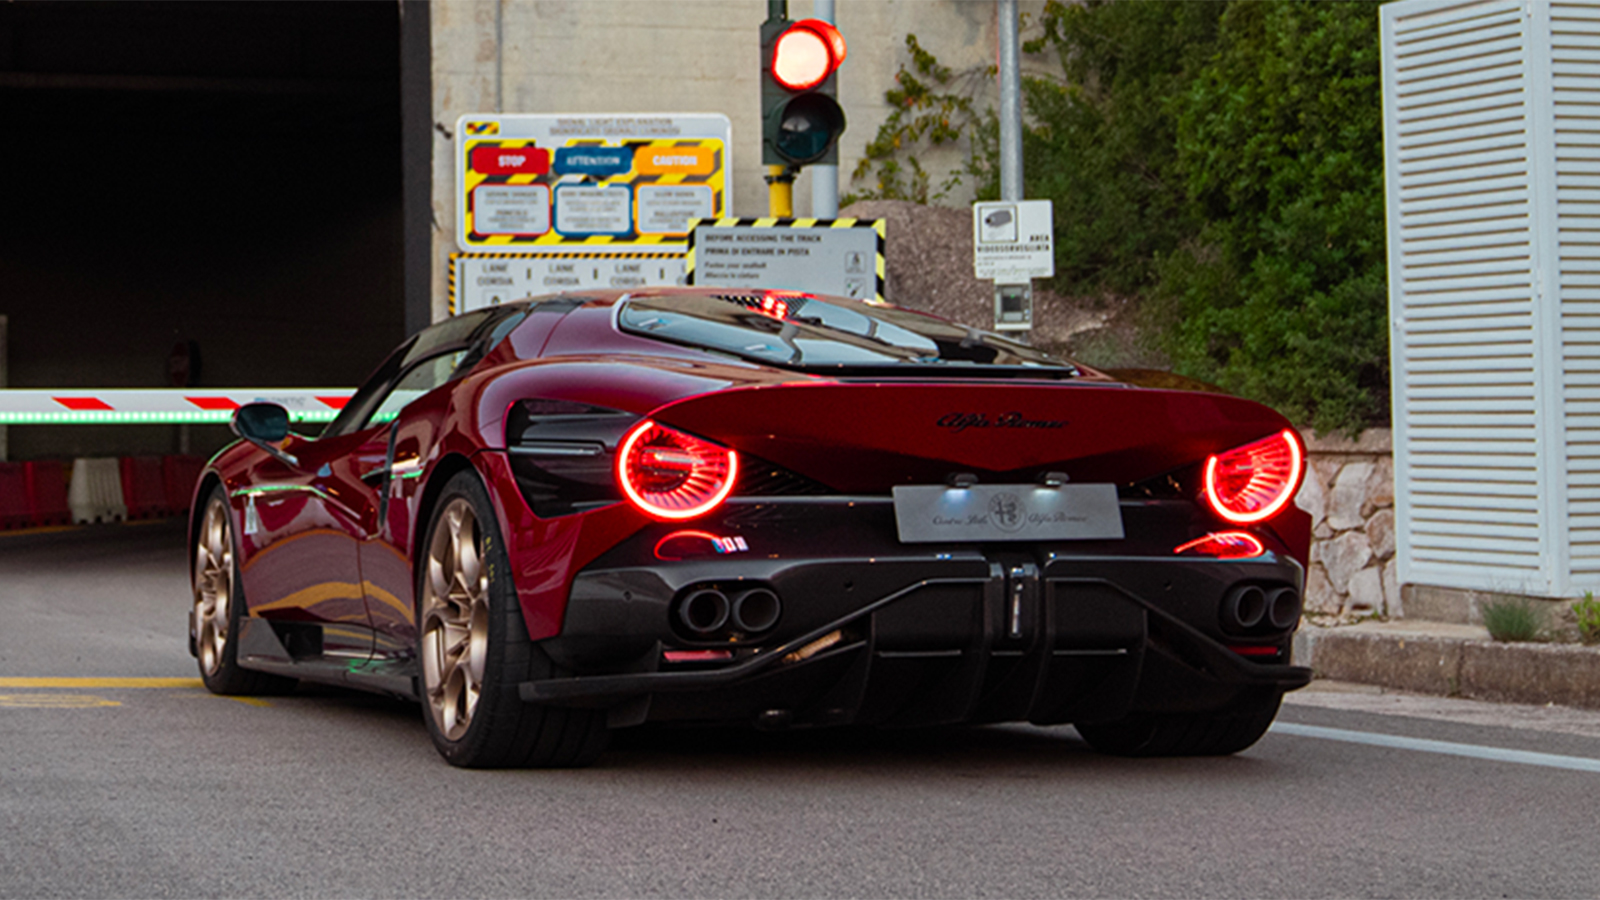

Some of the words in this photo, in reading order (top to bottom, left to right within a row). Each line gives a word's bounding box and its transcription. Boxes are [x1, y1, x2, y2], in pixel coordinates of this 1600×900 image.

[498, 155, 526, 167] STOP
[566, 155, 620, 166] ATTENTION
[652, 155, 698, 166] CAUTION
[705, 234, 733, 242] BEFORE
[736, 234, 778, 242] ACCESSING
[780, 234, 795, 242] THE
[797, 234, 822, 242] TRACK
[705, 247, 729, 255] PRIMA
[732, 247, 739, 255] DI
[741, 247, 775, 255] ENTRARE
[777, 247, 786, 255] IN
[788, 247, 810, 255] PISTA
[482, 264, 508, 273] LANE
[549, 264, 575, 273] LANE
[615, 264, 641, 273] LANE
[476, 277, 513, 286] CORSIA
[543, 277, 580, 286] CORSIA
[610, 277, 647, 286] CORSIA
[937, 412, 989, 432] Alfa
[995, 411, 1069, 429] Romeo
[1028, 512, 1051, 527] Alfa
[1053, 511, 1087, 523] Romeo
